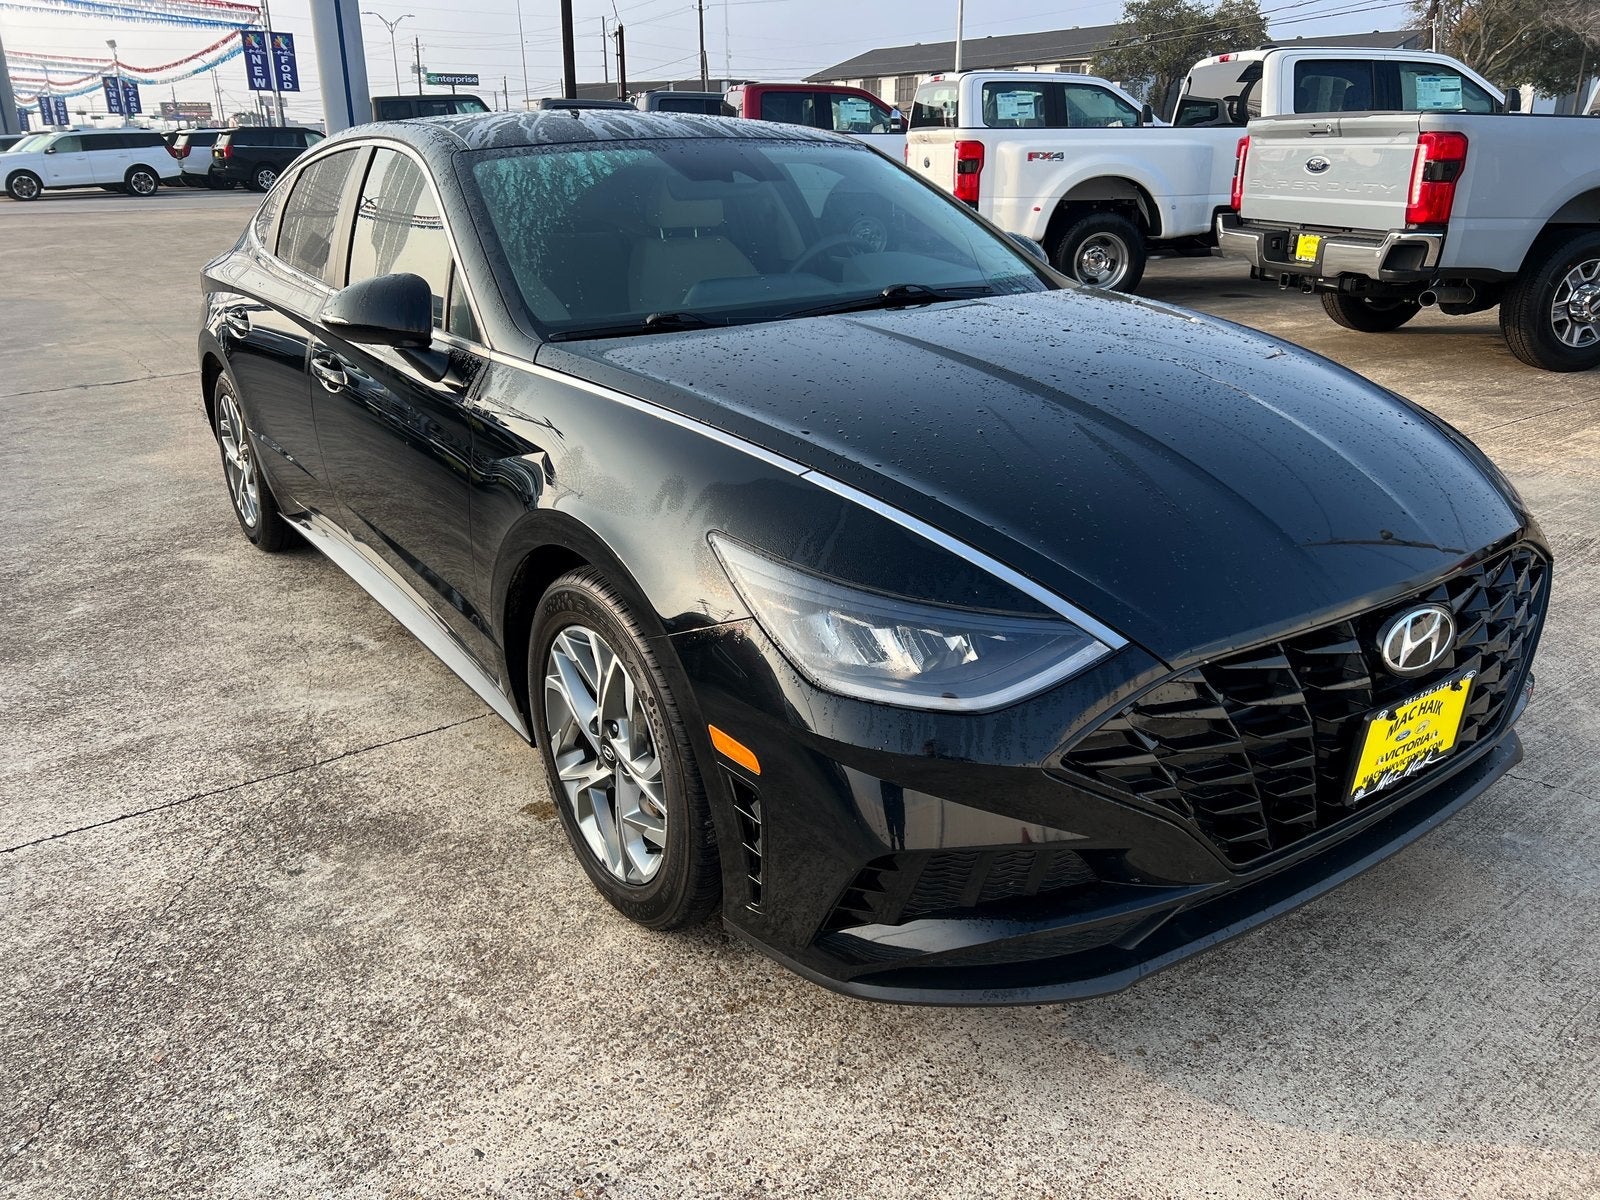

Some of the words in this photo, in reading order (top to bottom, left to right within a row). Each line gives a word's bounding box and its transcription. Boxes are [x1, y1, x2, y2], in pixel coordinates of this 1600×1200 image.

[251, 54, 266, 88] NEW
[280, 55, 293, 89] FORD
[428, 75, 478, 84] enterprise
[108, 91, 120, 113] NEW
[128, 91, 138, 113] FORD
[1027, 152, 1064, 161] FX4
[1250, 179, 1320, 191] SUPER
[1327, 182, 1398, 194] DUTY
[1386, 705, 1418, 740] MAC
[1418, 699, 1444, 716] HAIK
[1385, 732, 1430, 763] VICTORIA
